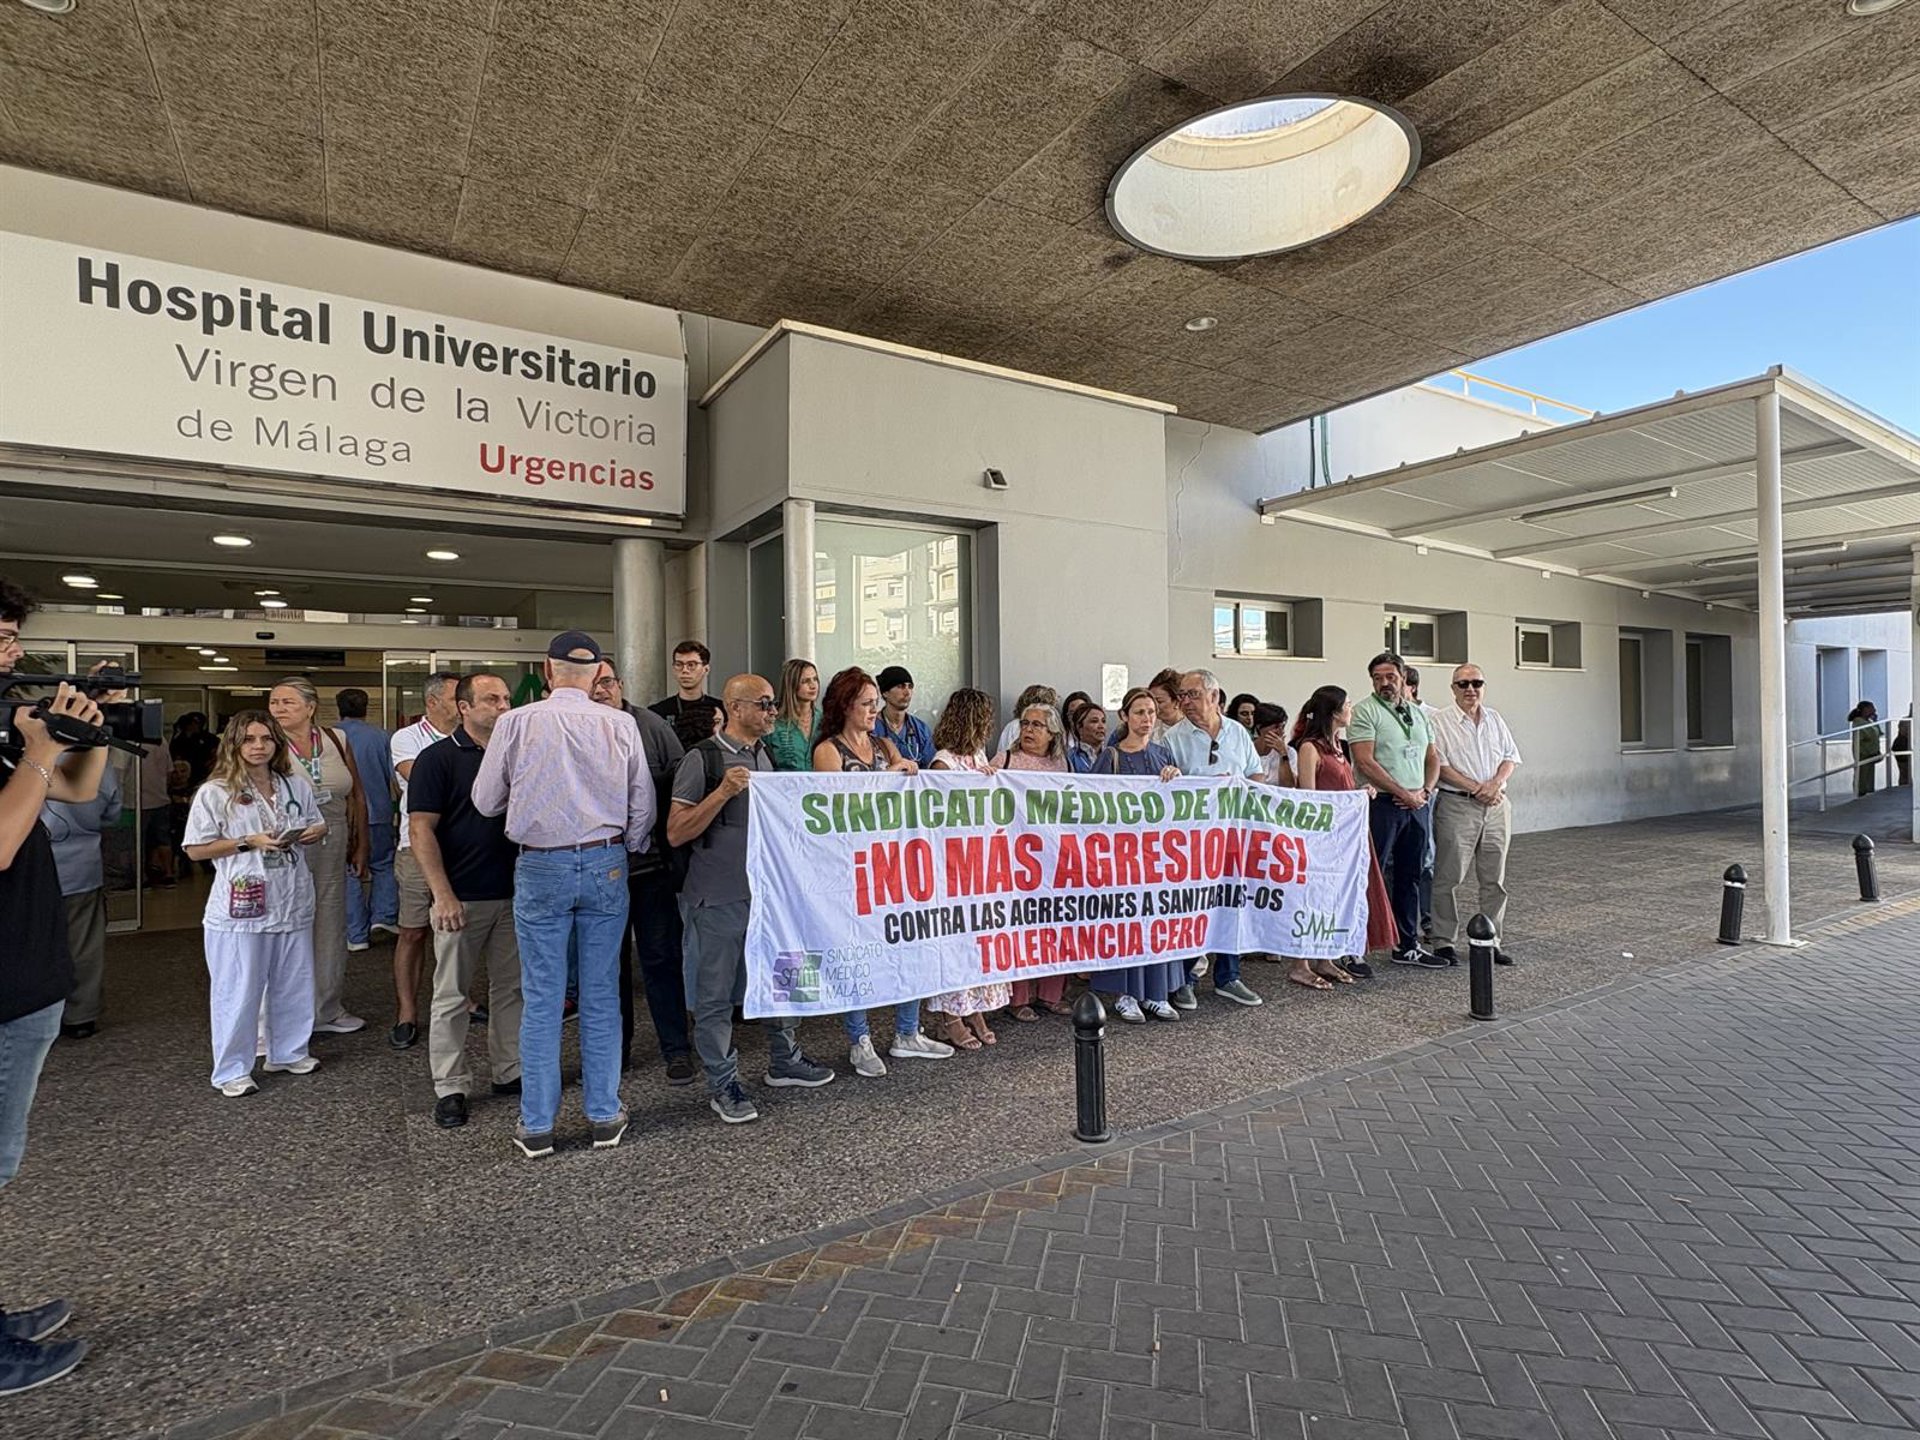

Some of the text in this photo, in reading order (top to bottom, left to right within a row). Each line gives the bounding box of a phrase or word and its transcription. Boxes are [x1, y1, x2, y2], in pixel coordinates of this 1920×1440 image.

[78, 256, 657, 399] Hospital Universitario
[175, 344, 656, 446] Virgen de la Victoria
[176, 409, 411, 466] de Málaga
[479, 443, 655, 490] Urgencias
[801, 784, 1335, 835] SINDICATO MÉDICO DE MÁLAGA
[854, 827, 1307, 917] ¡NO MÁS AGRESIONES!
[884, 883, 1285, 944] CONTRA LAS AGRESIONES A SANITARIAS-OS
[825, 962, 871, 981] MÉDICO
[826, 943, 884, 964] SINDICATO
[976, 913, 1208, 974] TOLERANCIA CERO
[825, 981, 875, 999] MÁLAGA
